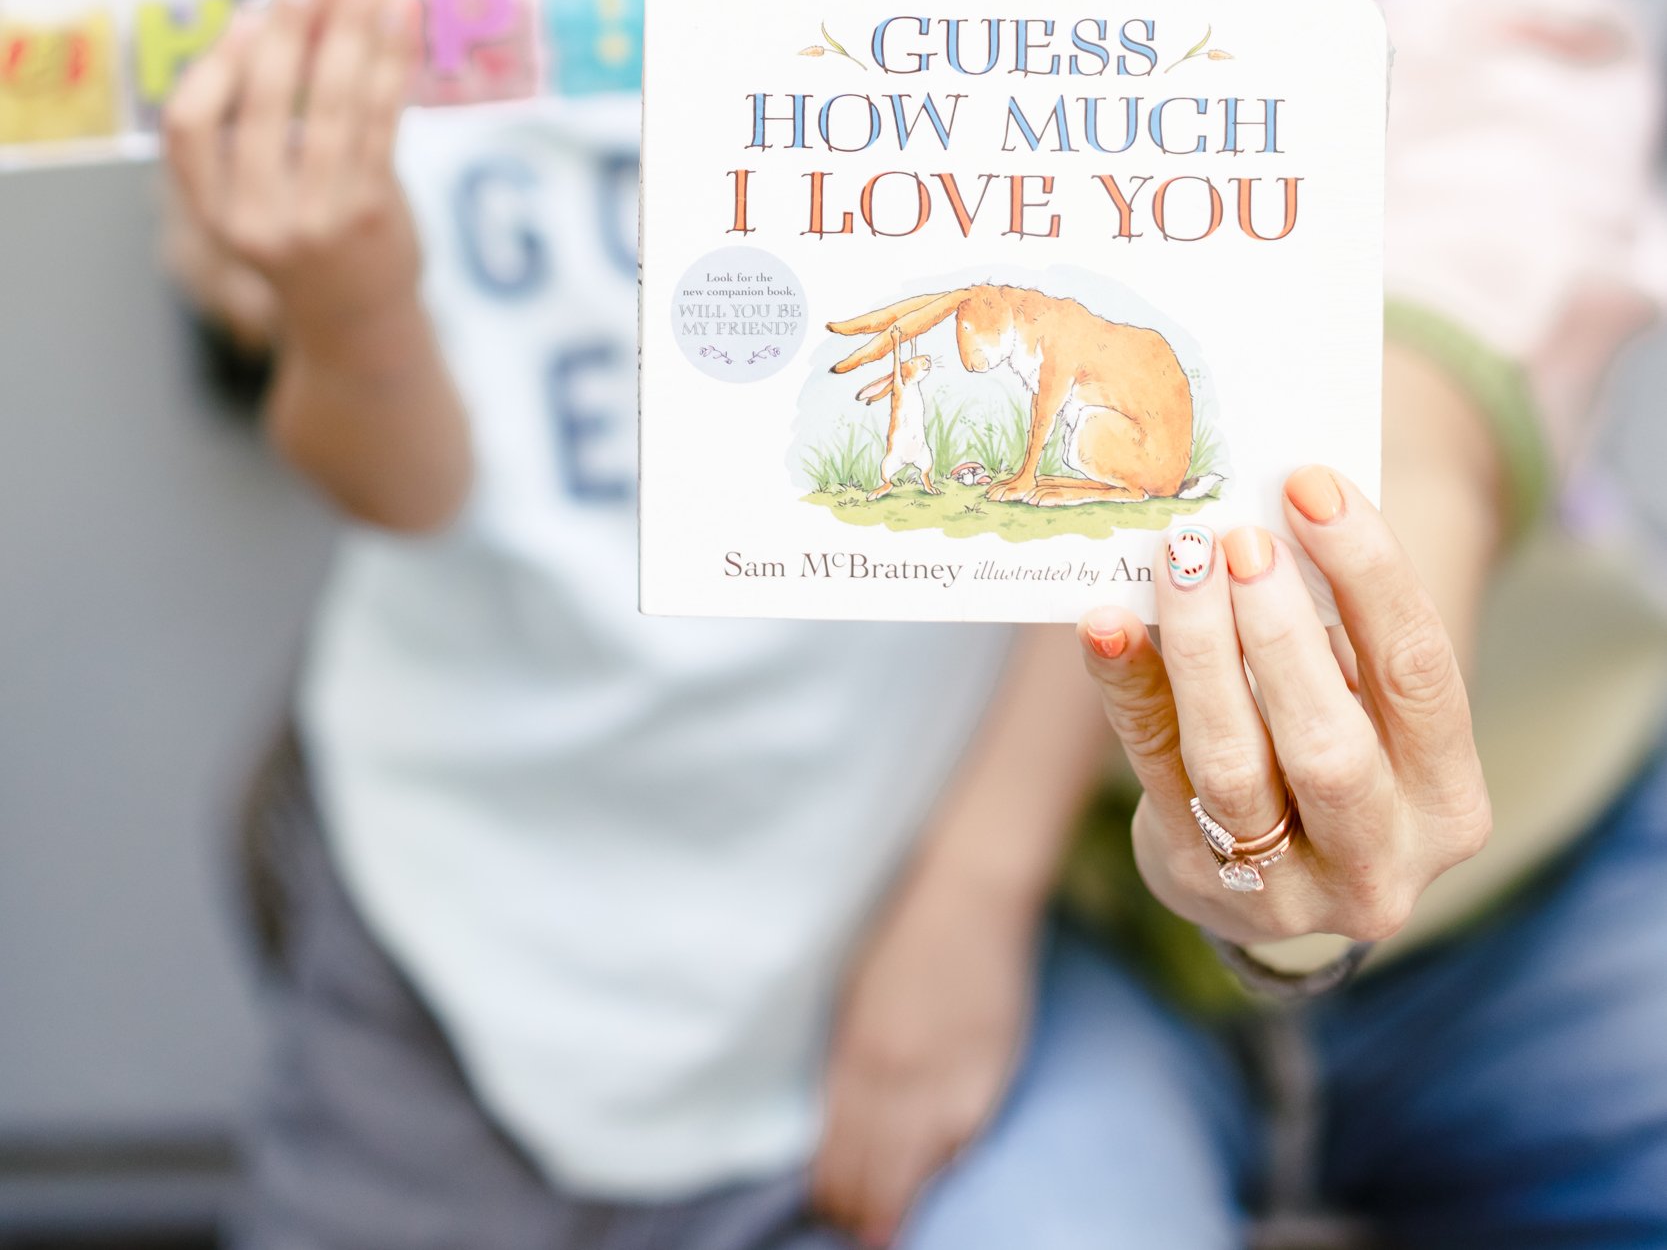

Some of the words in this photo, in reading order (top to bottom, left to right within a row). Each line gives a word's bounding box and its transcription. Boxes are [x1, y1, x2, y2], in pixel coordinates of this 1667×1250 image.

[871, 16, 1158, 78] GUESS
[744, 92, 969, 152] HOW
[1001, 94, 1286, 157] MUCH
[726, 169, 756, 237] I
[800, 171, 1061, 241] LOVE
[1091, 174, 1304, 243] YOU
[706, 273, 733, 283] Look
[737, 272, 753, 283] for
[756, 273, 773, 283] the
[706, 287, 764, 299] companion
[767, 286, 796, 298] book,
[679, 304, 726, 318] WILL
[730, 304, 770, 318] YOU
[777, 304, 802, 318] BE
[682, 322, 709, 335] MY
[716, 322, 798, 335] FRIEND?
[724, 551, 786, 578] Sam
[800, 552, 963, 589] McBratney
[973, 560, 1072, 582] illustrated
[1077, 562, 1101, 587] by
[1110, 557, 1155, 582] An
